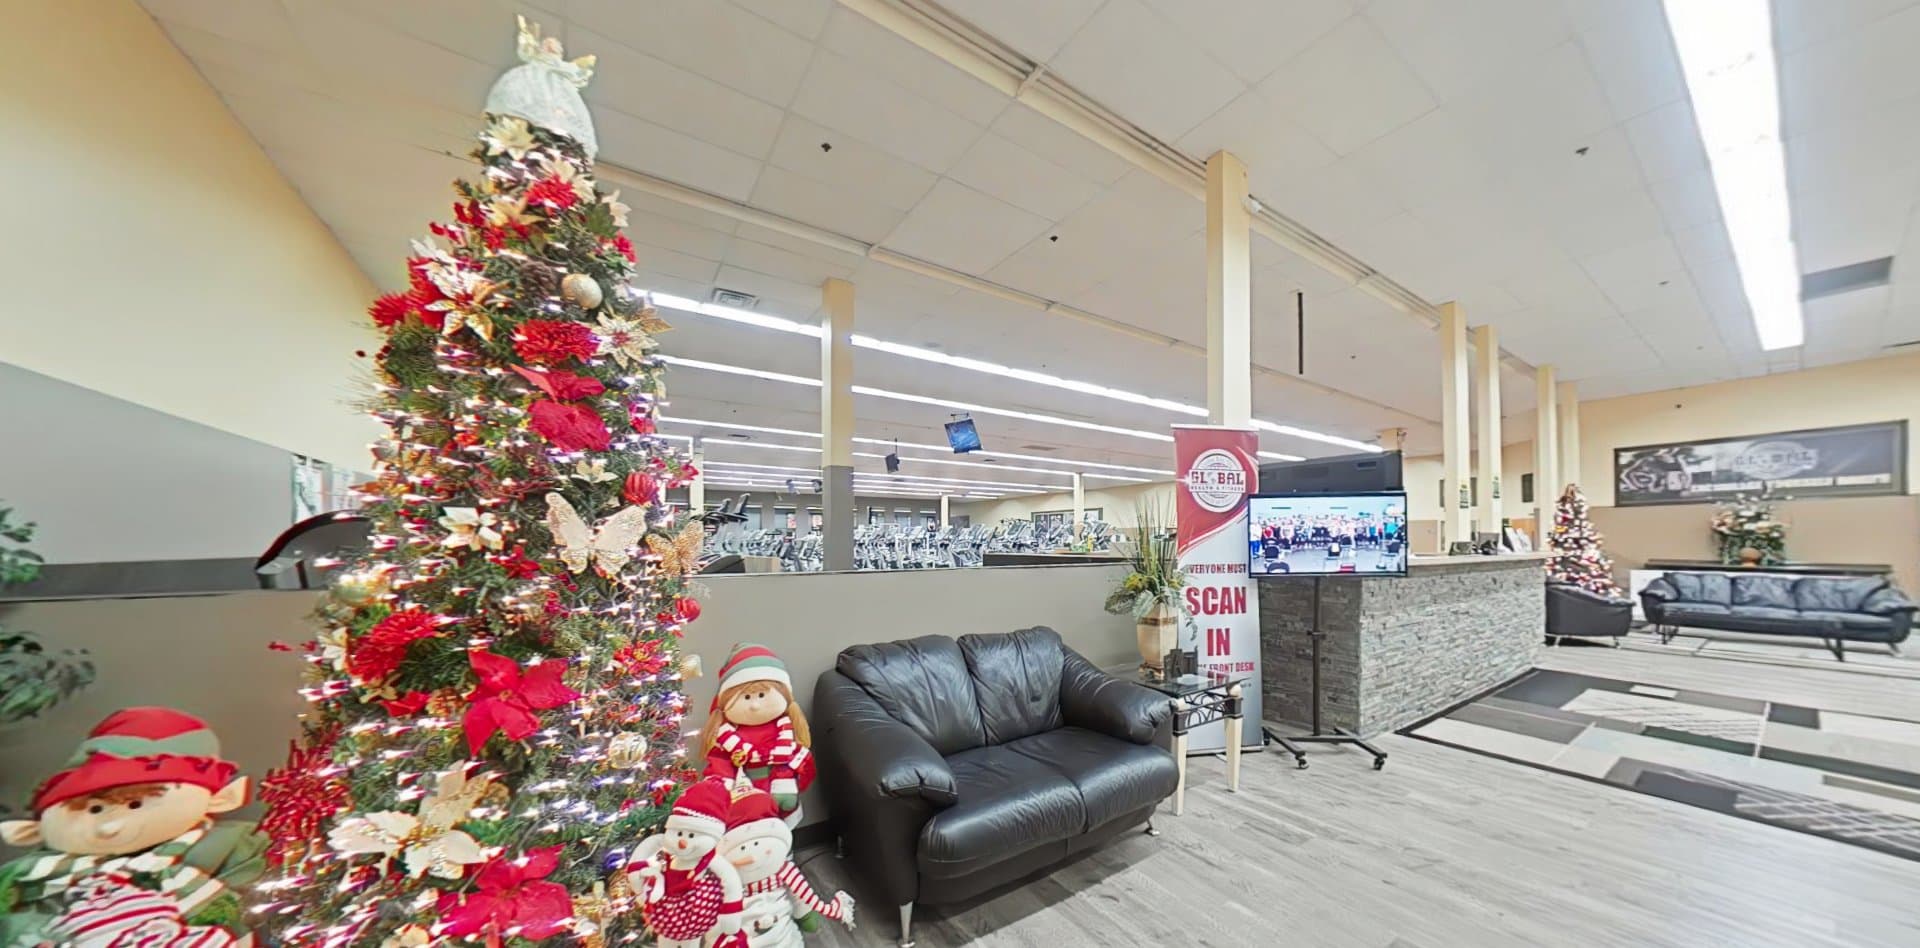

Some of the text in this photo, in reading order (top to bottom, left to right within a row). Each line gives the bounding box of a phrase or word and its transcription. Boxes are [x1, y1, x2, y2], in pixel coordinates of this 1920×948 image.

[1227, 563, 1246, 574] MUST
[1186, 586, 1247, 615] SCAN
[1207, 628, 1230, 656] IN
[1235, 661, 1254, 672] DESK
